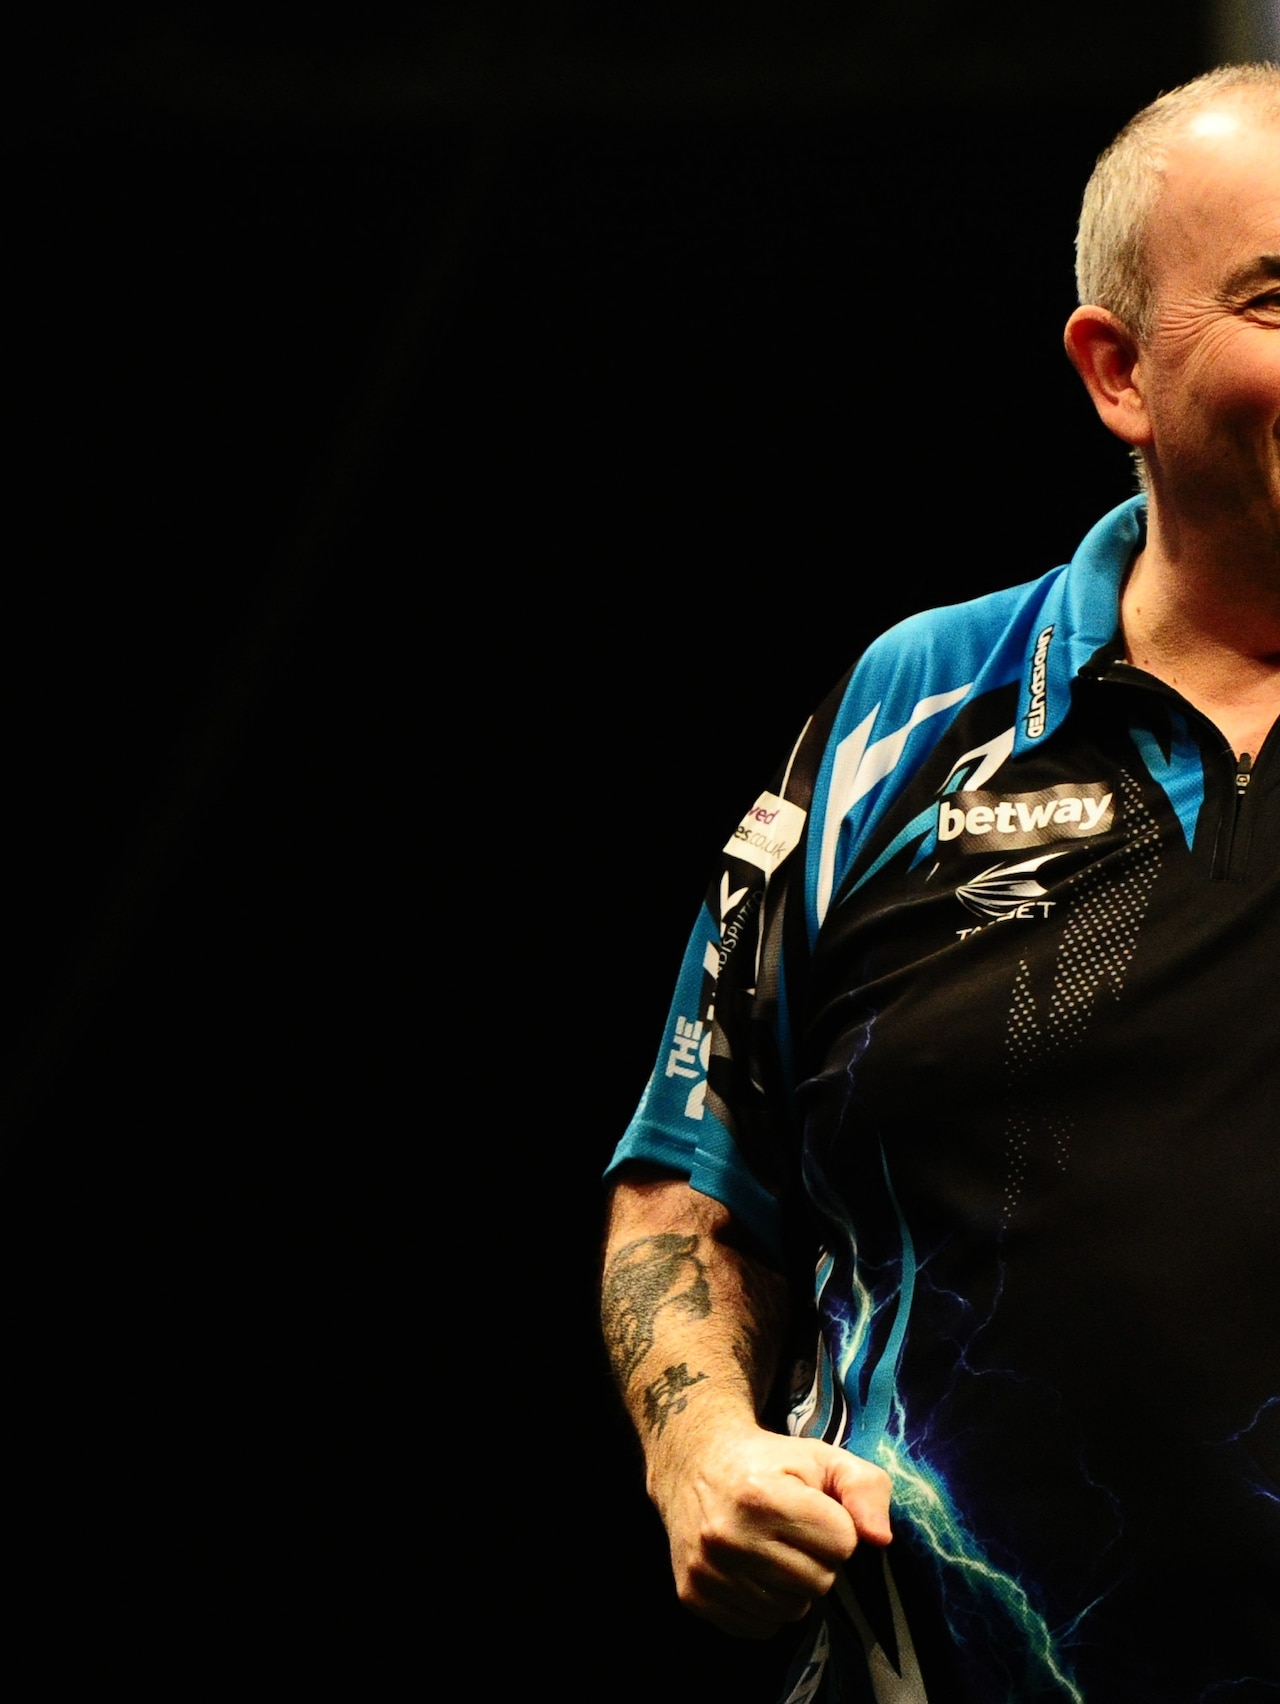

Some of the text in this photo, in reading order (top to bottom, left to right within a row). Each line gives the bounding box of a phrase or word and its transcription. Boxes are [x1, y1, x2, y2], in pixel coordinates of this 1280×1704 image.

[1026, 624, 1055, 739] UNDISPUTED
[937, 792, 1113, 842] betway
[956, 901, 1056, 941] TET
[665, 1016, 703, 1079] THE
